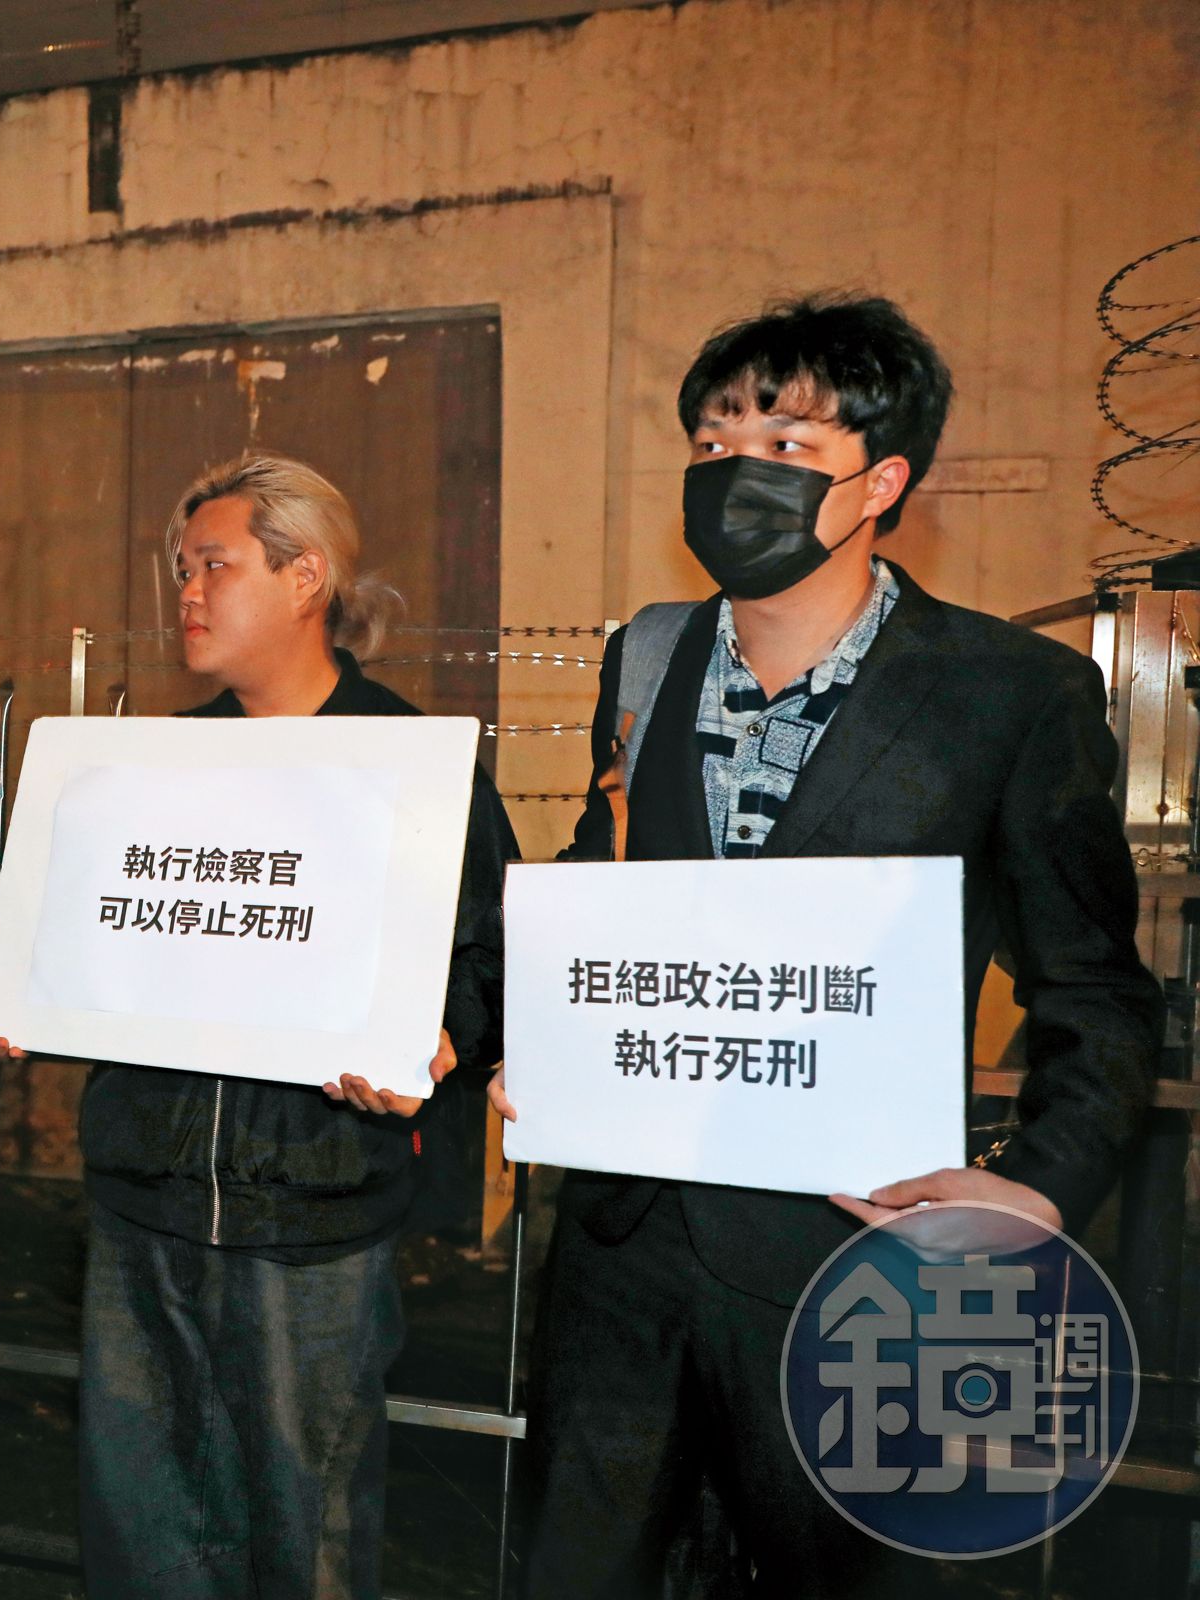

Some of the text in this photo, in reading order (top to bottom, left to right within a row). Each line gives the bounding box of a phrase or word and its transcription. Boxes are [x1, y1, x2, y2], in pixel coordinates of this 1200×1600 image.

[122, 844, 303, 887] 執行檢察官
[99, 896, 314, 943] 可以停止死刑
[568, 958, 877, 1018] 拒絕政治判斷
[614, 1028, 818, 1090] 執行死刑
